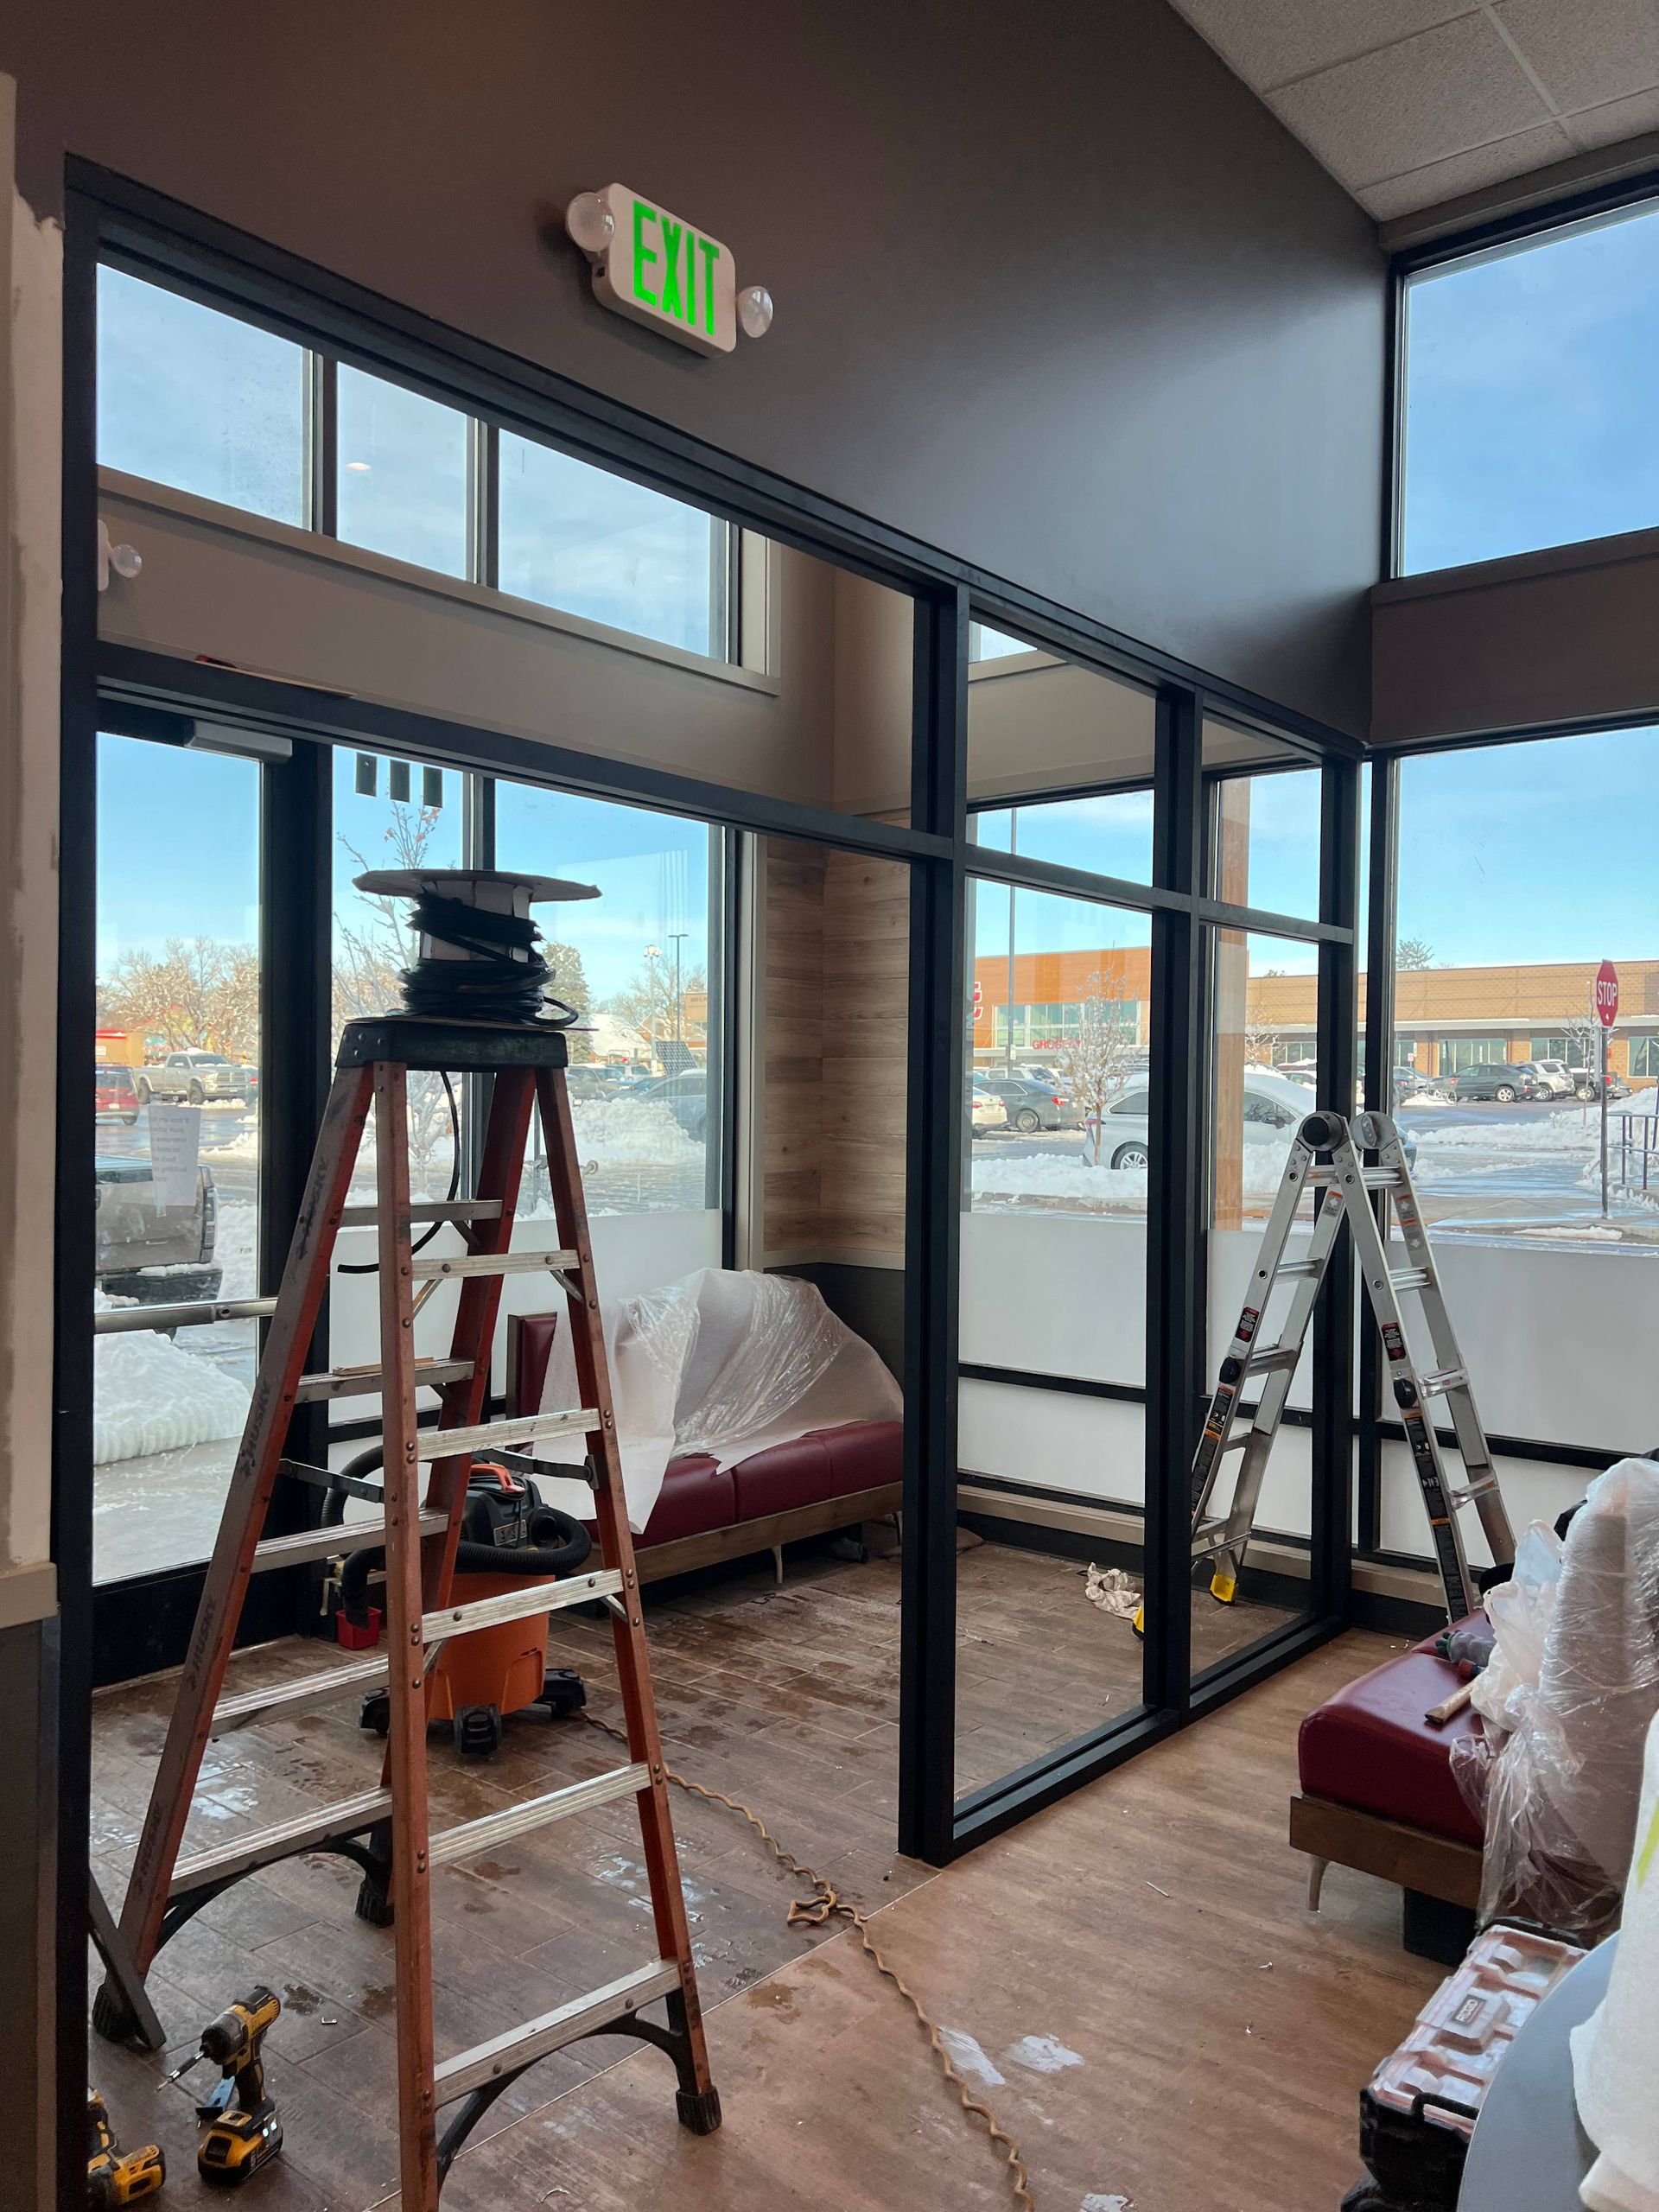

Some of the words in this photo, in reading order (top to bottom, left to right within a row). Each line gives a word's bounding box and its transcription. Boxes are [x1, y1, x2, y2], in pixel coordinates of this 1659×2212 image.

[633, 200, 720, 335] EXIT
[1598, 981, 1618, 1007] STOP
[1033, 1039, 1083, 1050] GROCEY
